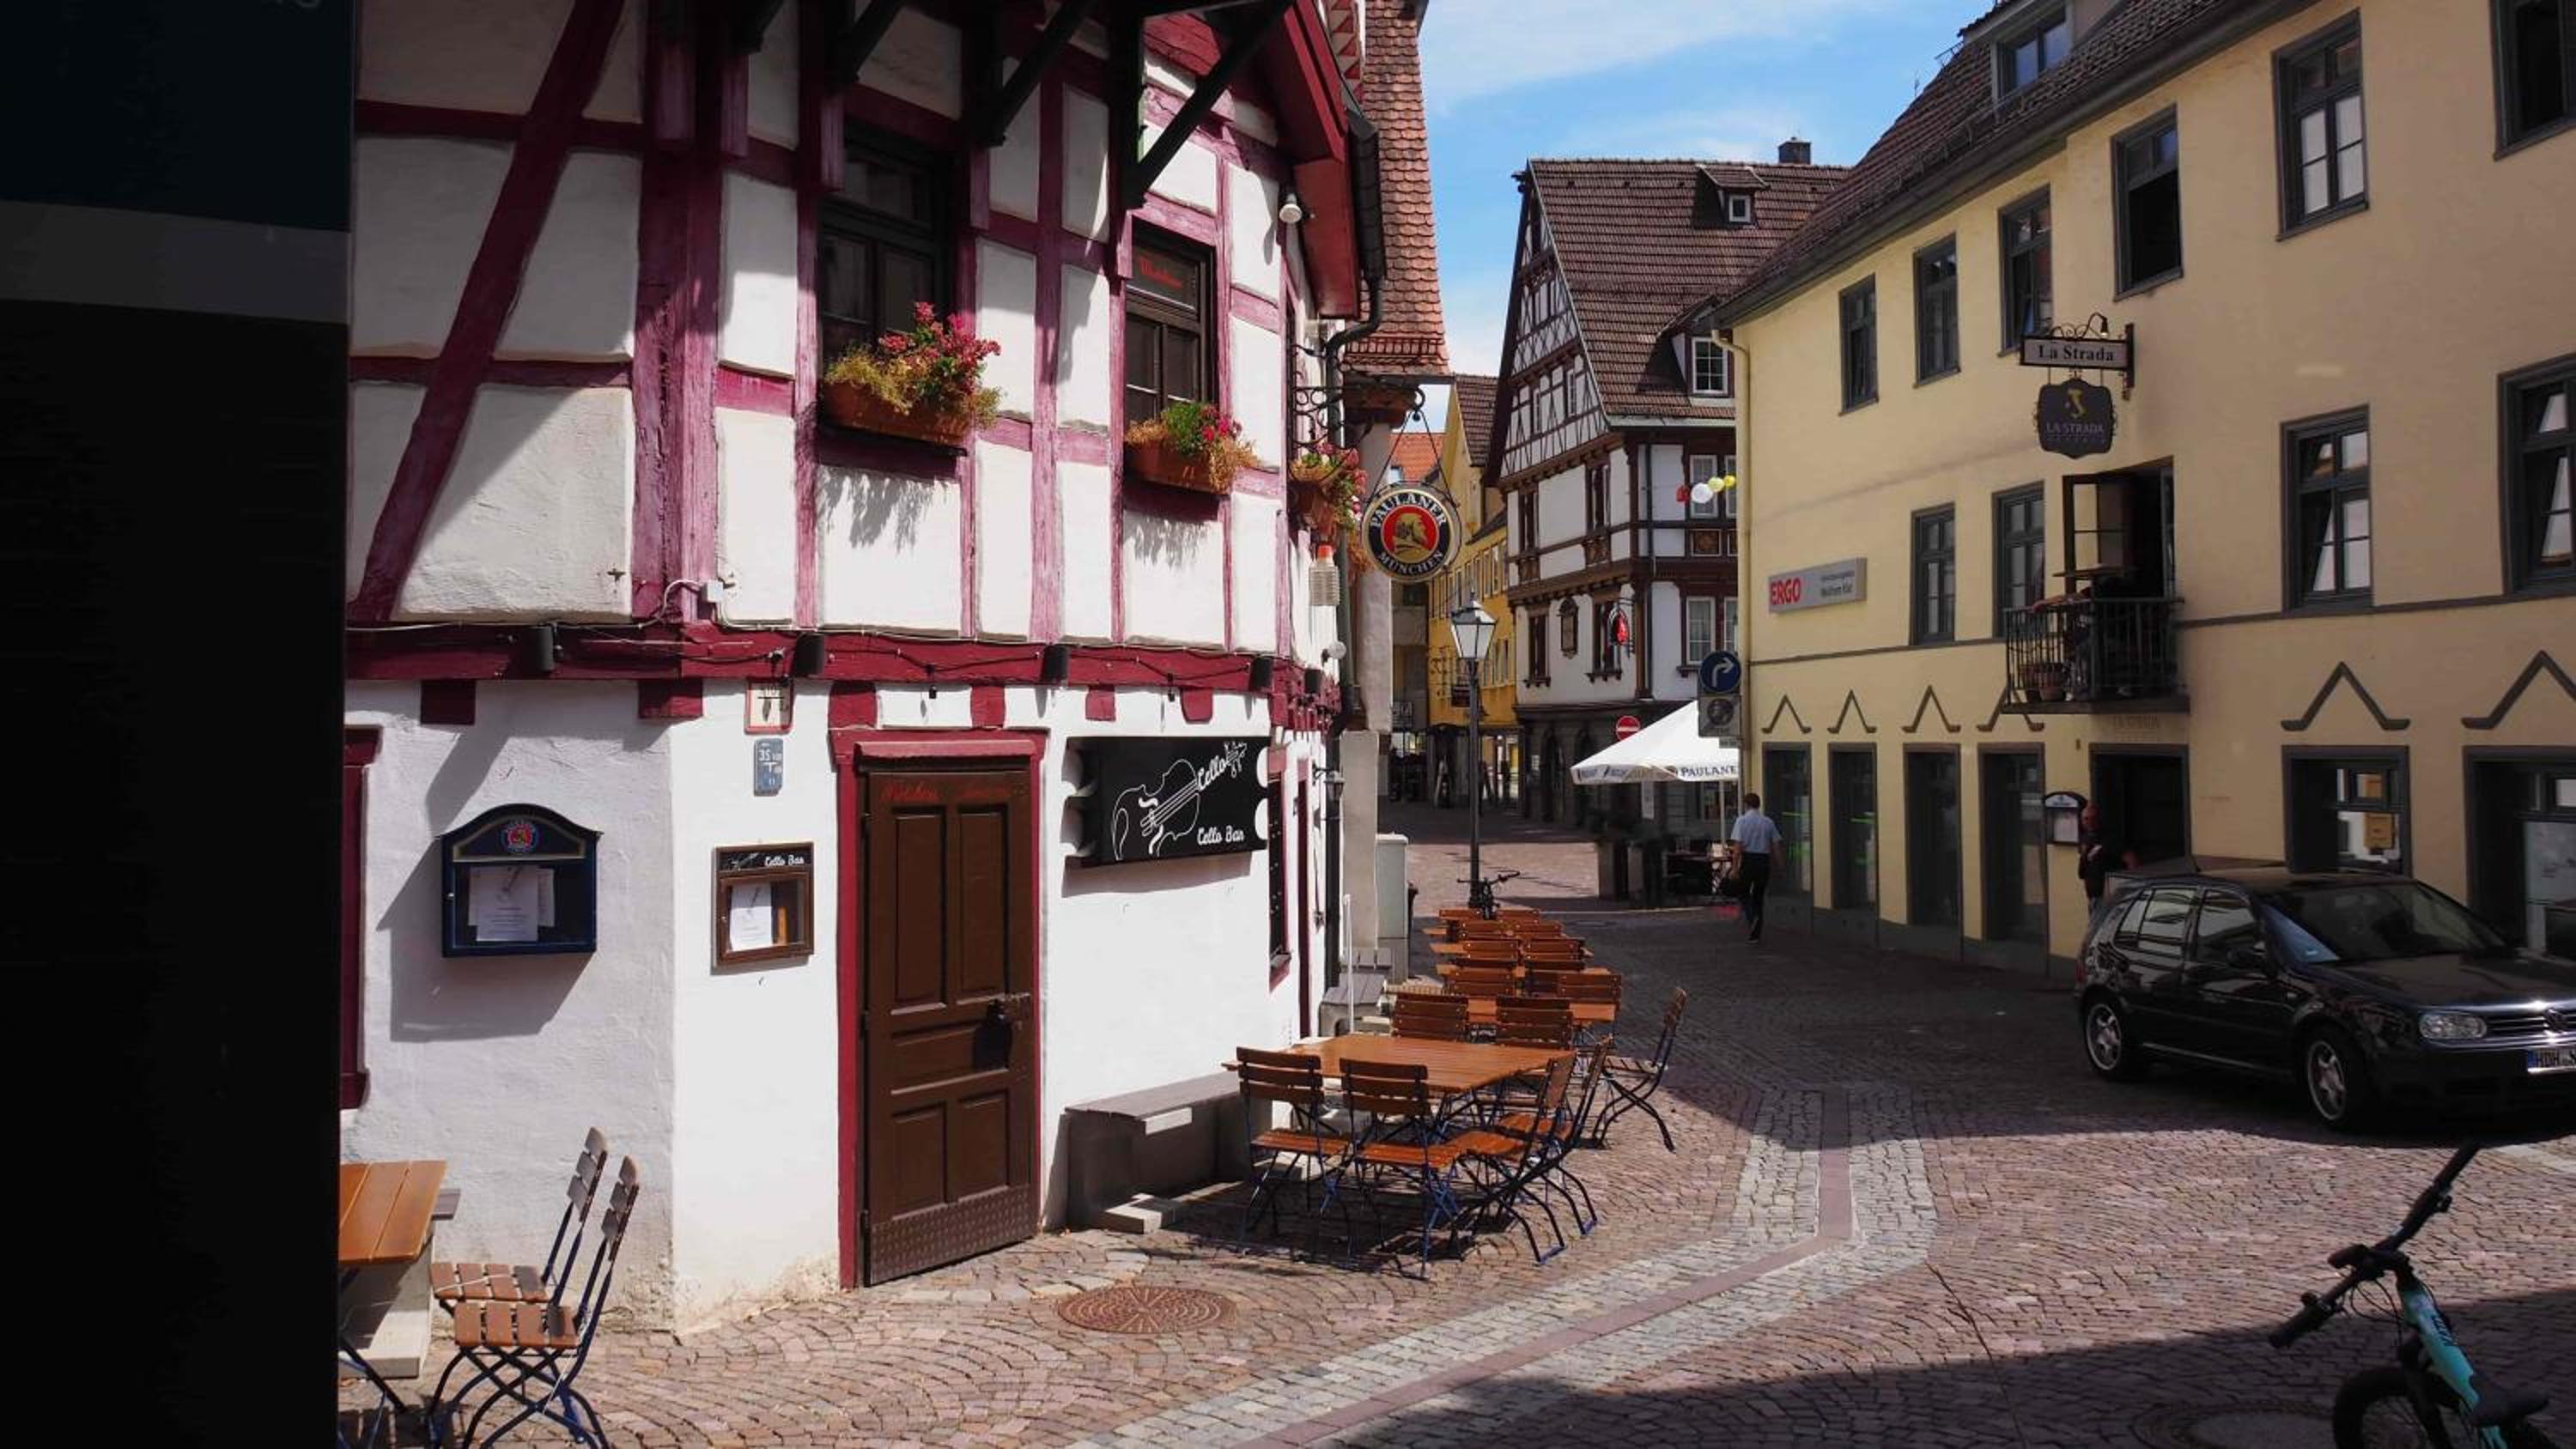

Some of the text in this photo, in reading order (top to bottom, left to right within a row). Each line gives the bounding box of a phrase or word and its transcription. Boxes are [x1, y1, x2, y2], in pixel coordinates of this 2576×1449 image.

[2038, 344, 2115, 361] La Strada
[2046, 422, 2105, 434] LA STRADA
[1370, 494, 1447, 527] PAULANER
[1771, 577, 1802, 605] ERGO
[1198, 755, 1227, 791] Cello
[1680, 764, 1738, 778] PAULANE
[1196, 824, 1246, 845] Cello Bar
[764, 855, 786, 866] Cello
